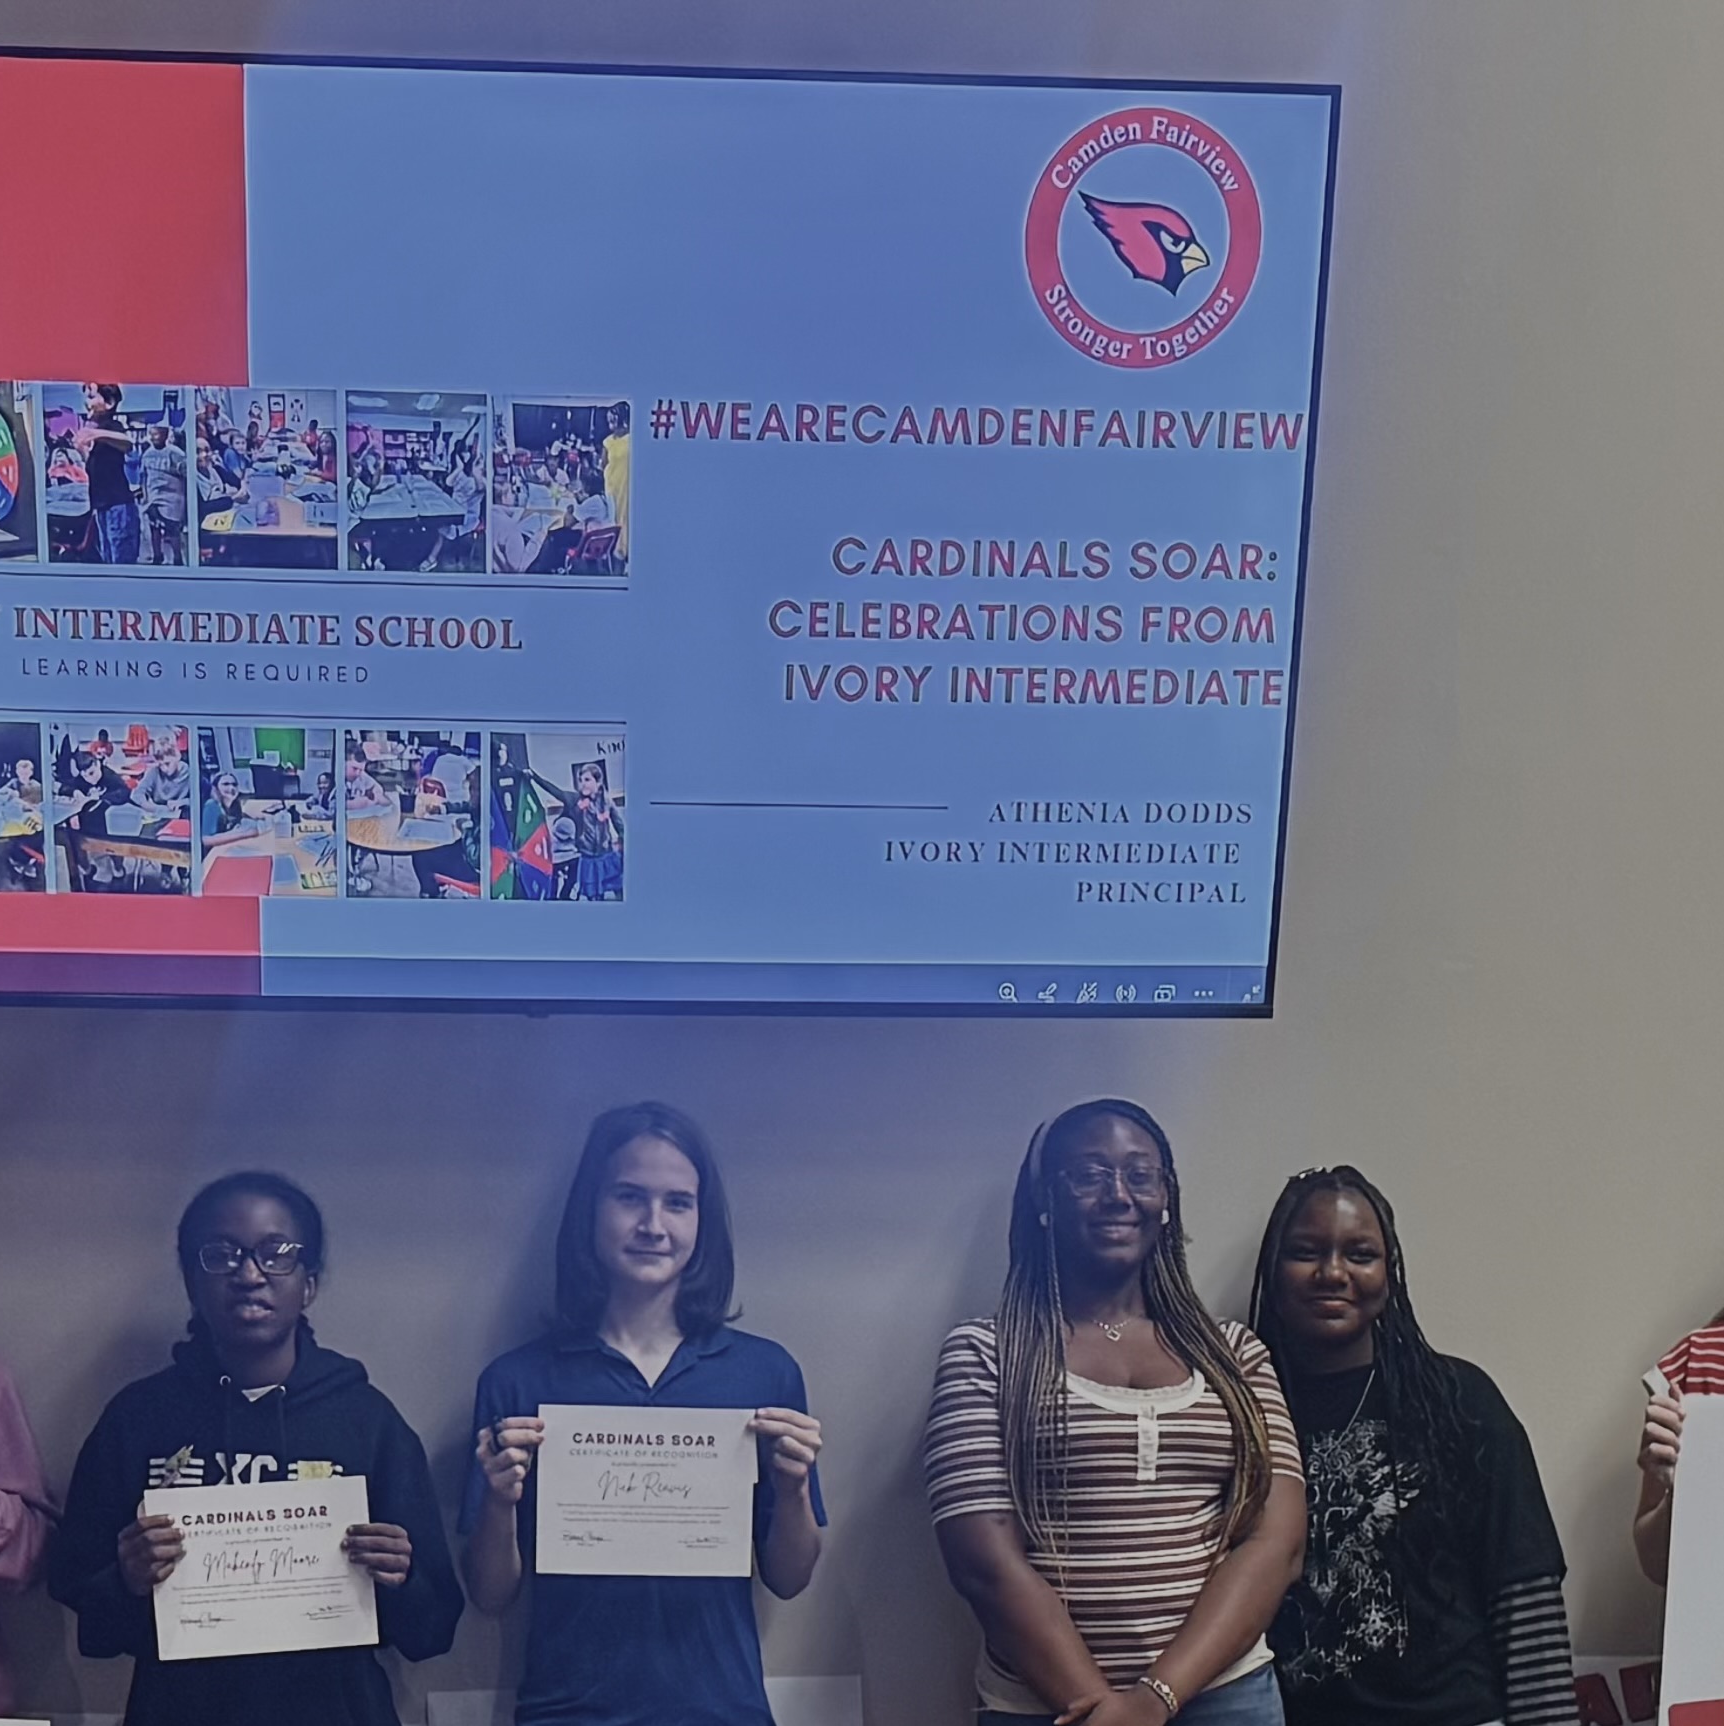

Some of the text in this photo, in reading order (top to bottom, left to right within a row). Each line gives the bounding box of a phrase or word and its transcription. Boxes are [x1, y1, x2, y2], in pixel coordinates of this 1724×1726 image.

[1050, 116, 1239, 192] Camden Fairview
[1044, 283, 1236, 360] Stronger Together
[650, 399, 1304, 450] #WEARECAMDENFAIRVIEW
[831, 536, 1278, 582] CARDINALS SOAR:
[13, 607, 342, 648] INTERMEDIATE
[355, 615, 524, 652] SCHOOL
[769, 599, 1276, 646] CELEBRATIONS FROM
[21, 658, 370, 685] LEARNING IS REQUIRED
[784, 663, 1284, 707] IVORY INTERMEDIATE
[988, 802, 1253, 826] ATHENIA DODDS
[884, 841, 1242, 866] IVORY INTERMEDIATE
[1076, 880, 1248, 905] PRINCIPAL
[572, 1432, 716, 1447] CARDINALS SOAR
[181, 1505, 328, 1526] CARDINALS SOAR
[187, 1527, 242, 1539] ERTIFICATE
